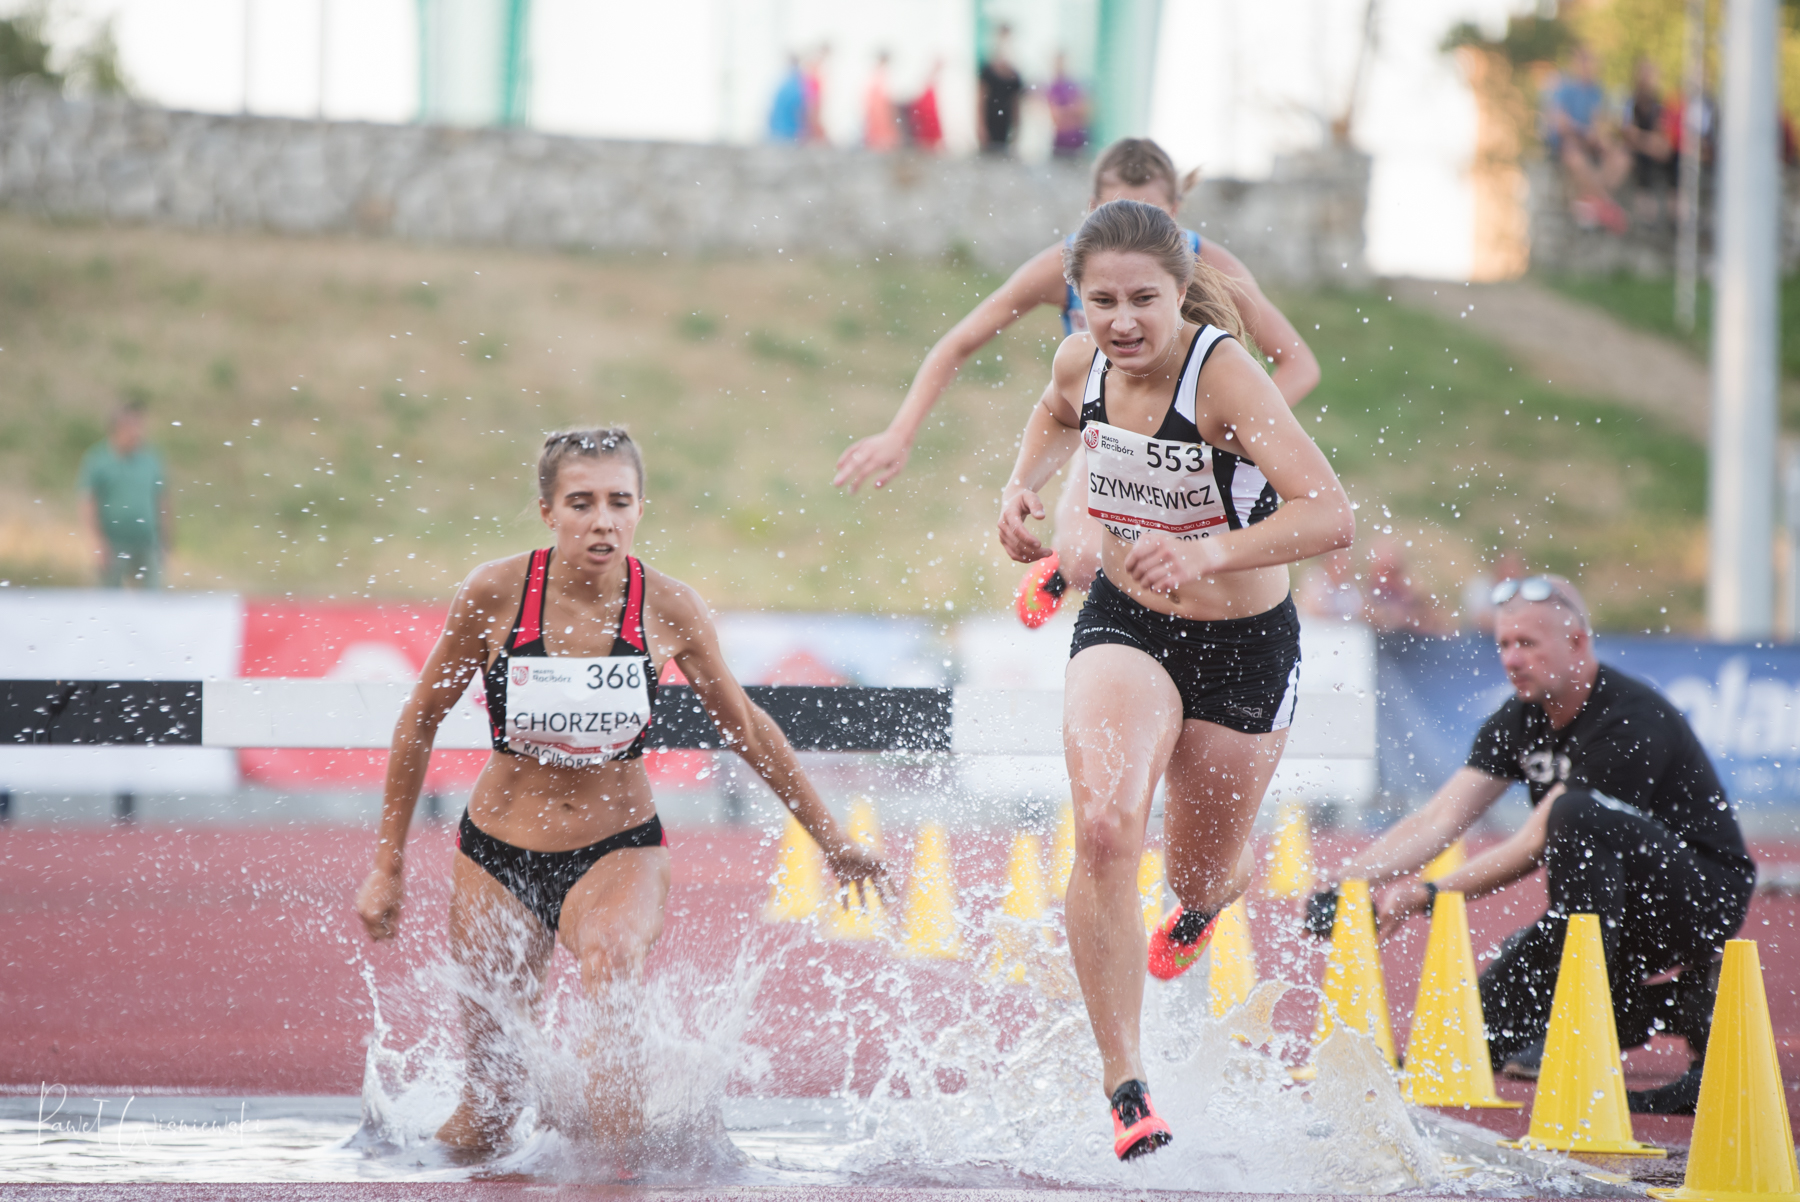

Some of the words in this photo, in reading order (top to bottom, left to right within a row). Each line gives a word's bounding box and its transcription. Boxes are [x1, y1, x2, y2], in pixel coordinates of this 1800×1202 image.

[1101, 435, 1119, 444] MIASTO
[1101, 440, 1135, 456] Racibórz
[1146, 441, 1205, 473] 553
[1090, 472, 1215, 510] SZYMKIEWICZ
[1082, 626, 1104, 635] OLIMP
[586, 663, 641, 690] 368
[513, 711, 642, 735] CHORZĘPA
